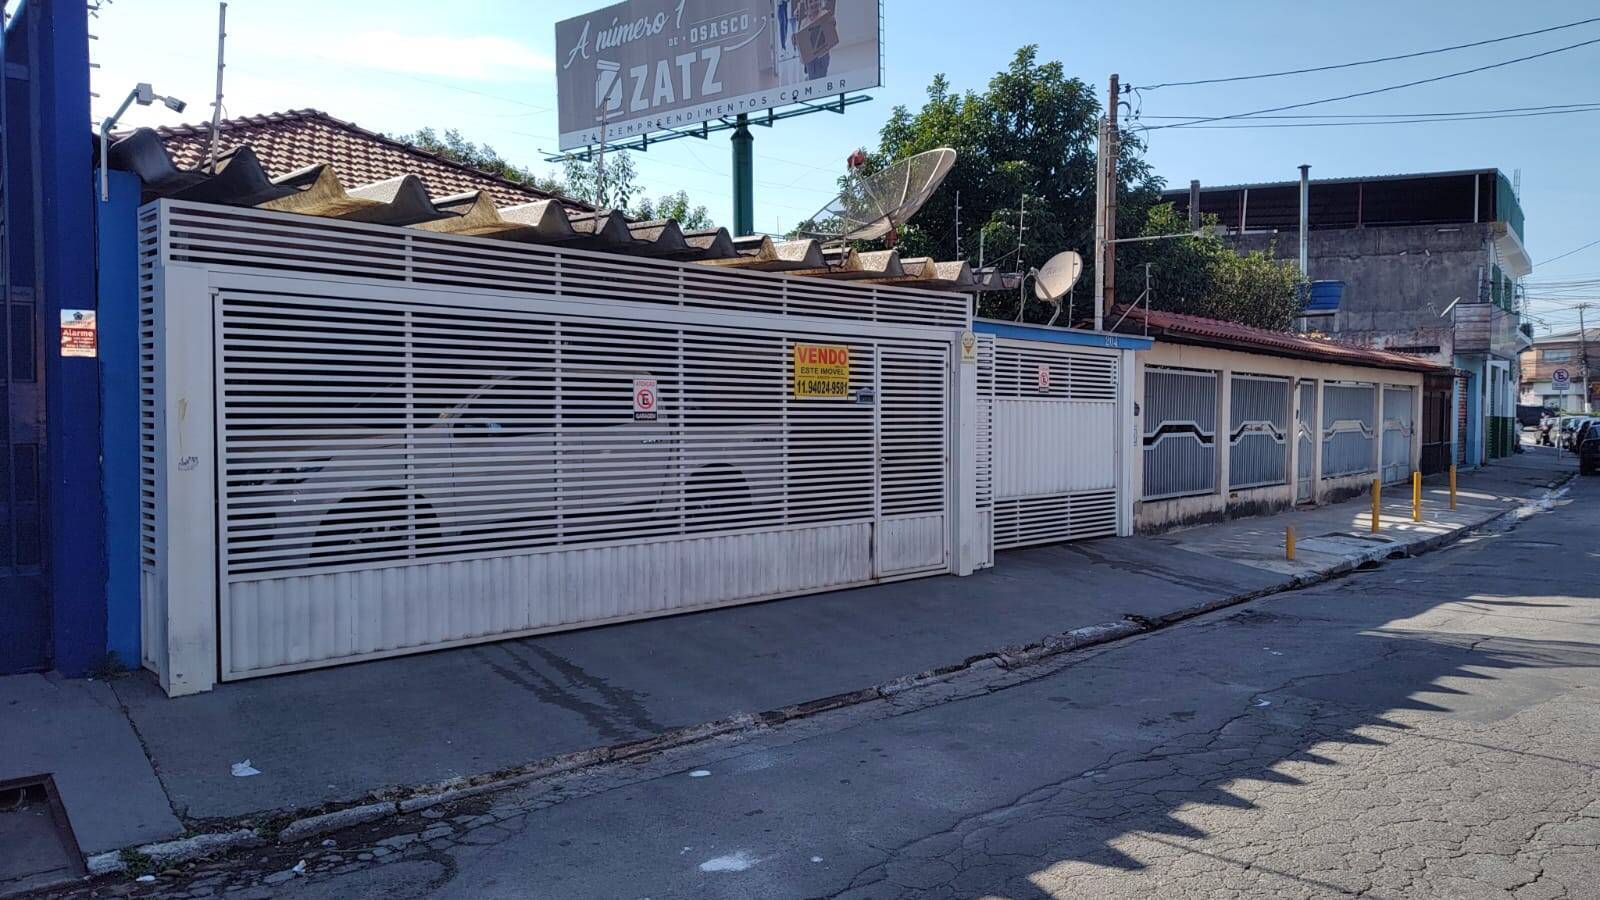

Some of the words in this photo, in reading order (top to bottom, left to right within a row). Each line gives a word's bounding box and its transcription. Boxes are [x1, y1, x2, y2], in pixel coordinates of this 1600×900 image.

[563, 20, 589, 69] A
[596, 11, 669, 52] número
[690, 14, 749, 43] OSASCO
[630, 46, 722, 112] ZATZ
[582, 79, 846, 143] ZAZEMPREENDIMENTOS.COM.BR
[1105, 335, 1118, 346] 204
[797, 346, 847, 365] VENDO
[800, 366, 818, 374] ESTE
